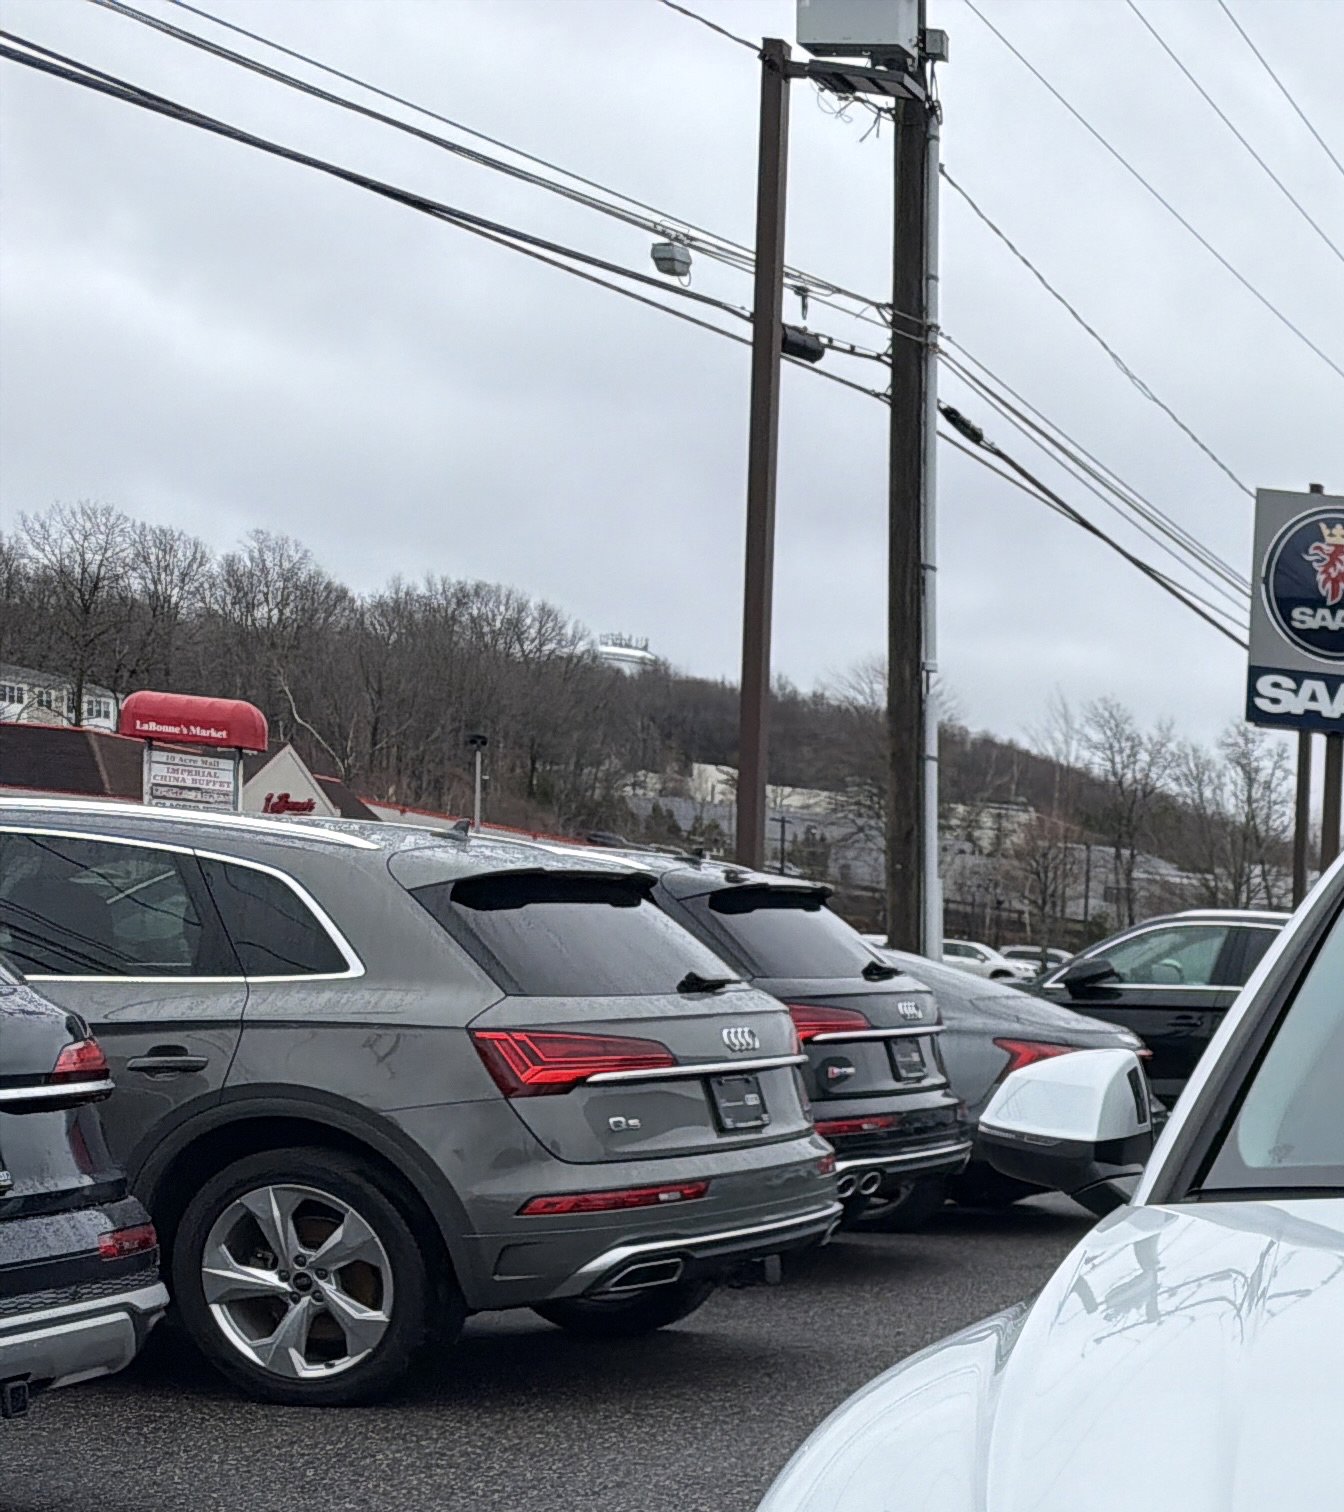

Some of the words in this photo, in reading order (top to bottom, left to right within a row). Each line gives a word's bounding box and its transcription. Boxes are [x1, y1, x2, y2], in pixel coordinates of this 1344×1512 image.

[135, 719, 188, 735] LaBonne's
[189, 725, 228, 739] Market
[179, 756, 199, 765] Acre
[200, 758, 220, 768] Mall
[152, 773, 187, 784] CHINA
[191, 778, 232, 789] BUFFET
[166, 767, 220, 779] IMPERIAL
[608, 1116, 642, 1132] Q5
